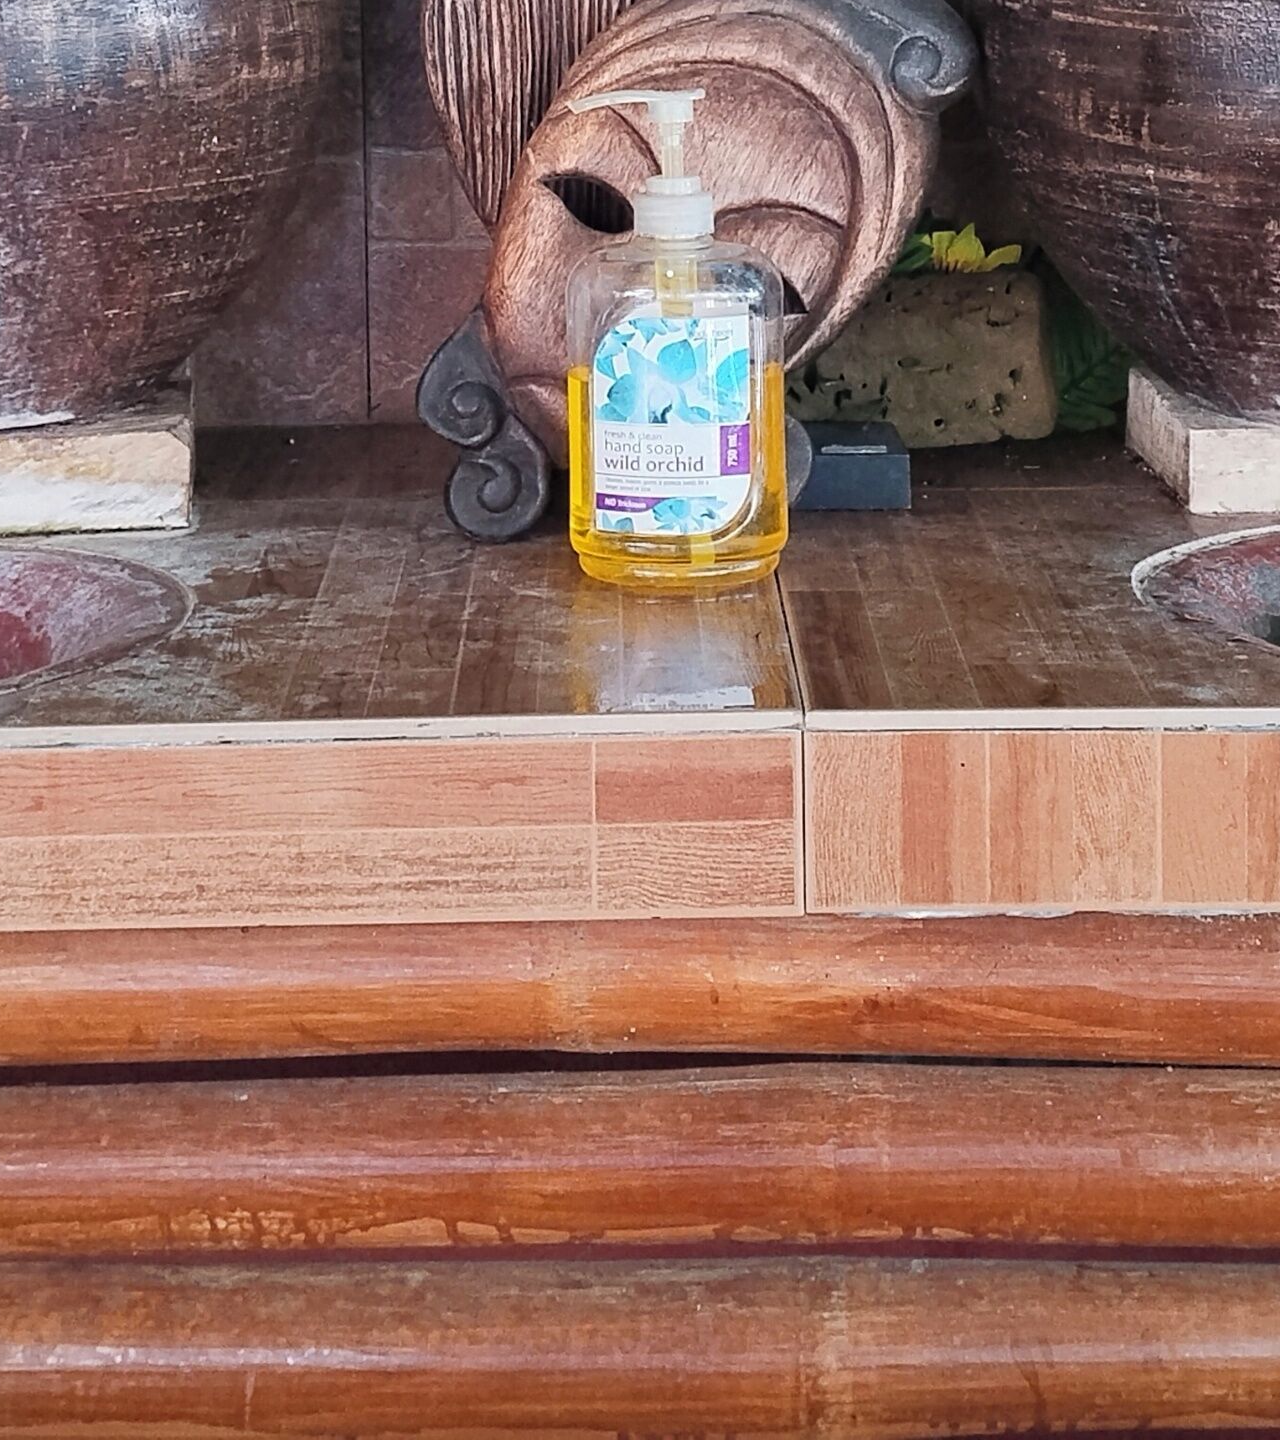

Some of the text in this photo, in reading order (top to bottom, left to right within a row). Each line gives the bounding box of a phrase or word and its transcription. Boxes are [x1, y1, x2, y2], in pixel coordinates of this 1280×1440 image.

[604, 430, 626, 440] fresh
[604, 438, 684, 457] hand soap
[604, 455, 704, 472] wild orchid
